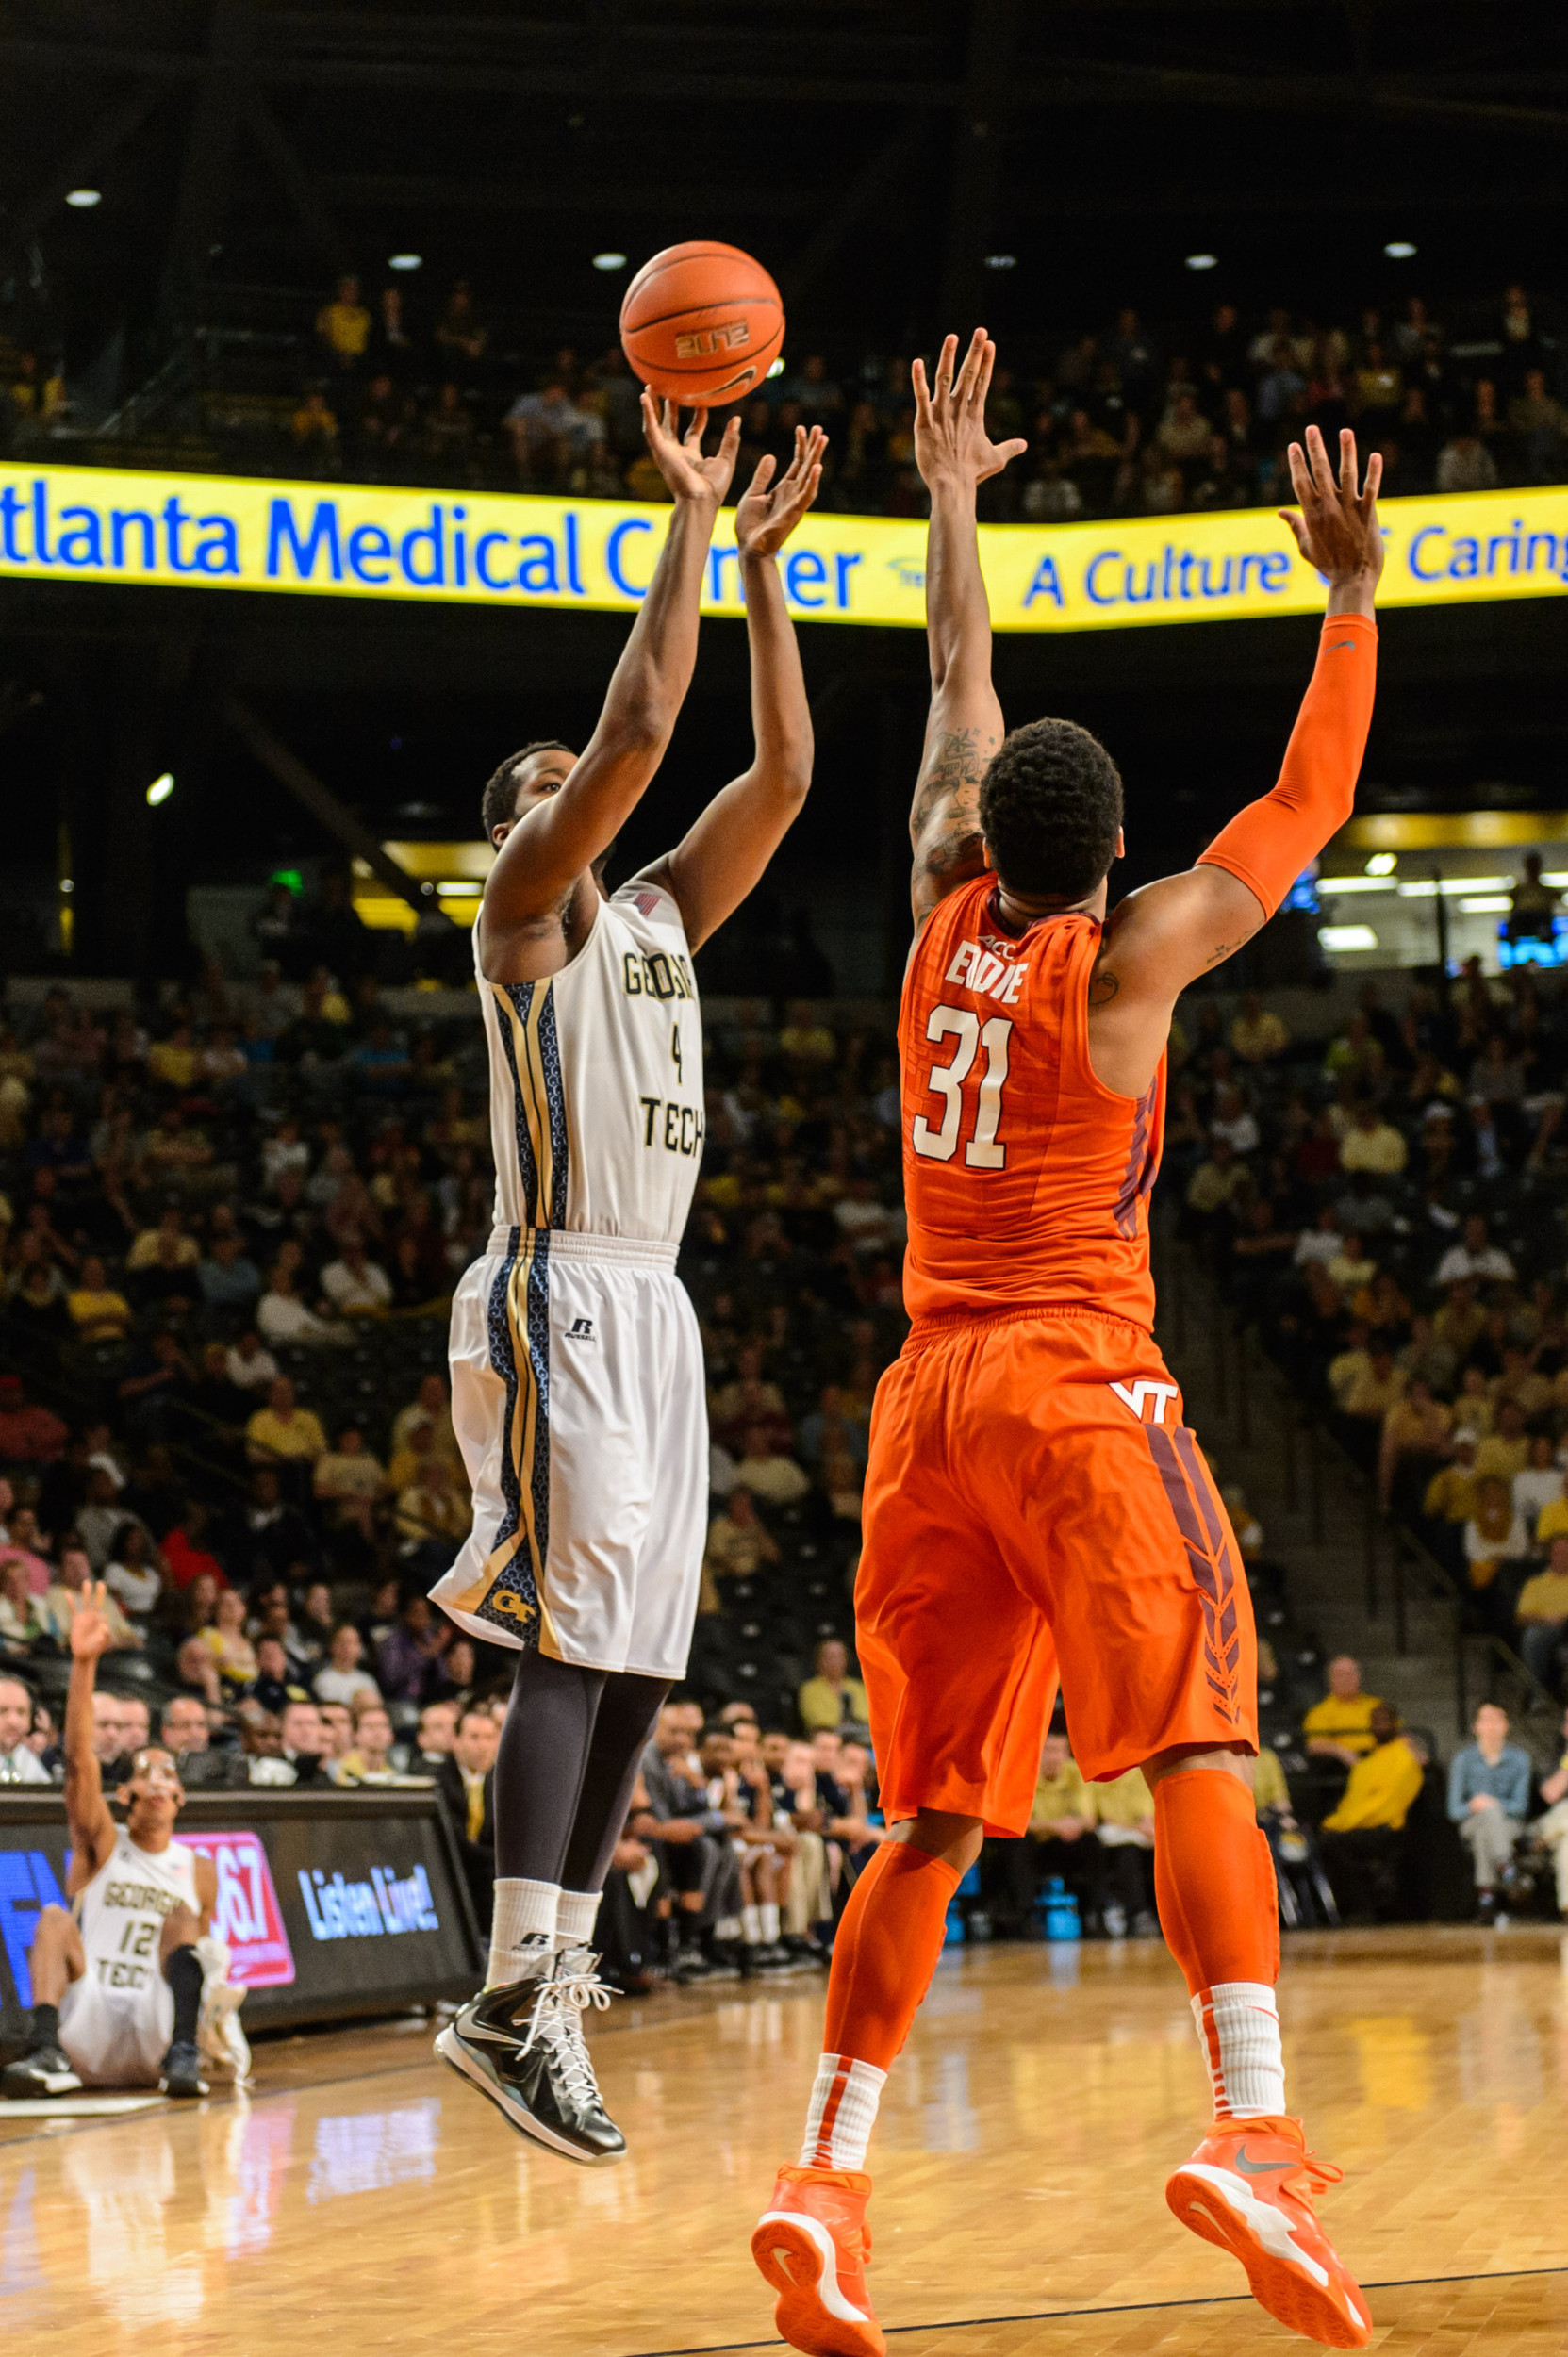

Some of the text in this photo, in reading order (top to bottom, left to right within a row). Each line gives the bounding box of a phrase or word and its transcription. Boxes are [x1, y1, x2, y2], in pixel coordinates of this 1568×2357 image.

[0, 479, 862, 607] tlanta Medical Cner
[1023, 555, 1065, 608] A
[1085, 544, 1291, 605] Culture
[977, 934, 1016, 961] ACC
[912, 1004, 1013, 1170] 31
[640, 1096, 704, 1159] TECH
[1107, 1379, 1179, 1424] VT
[297, 1865, 385, 1940] Listen
[118, 1920, 157, 1957] 12
[96, 1958, 149, 1990] TEC
